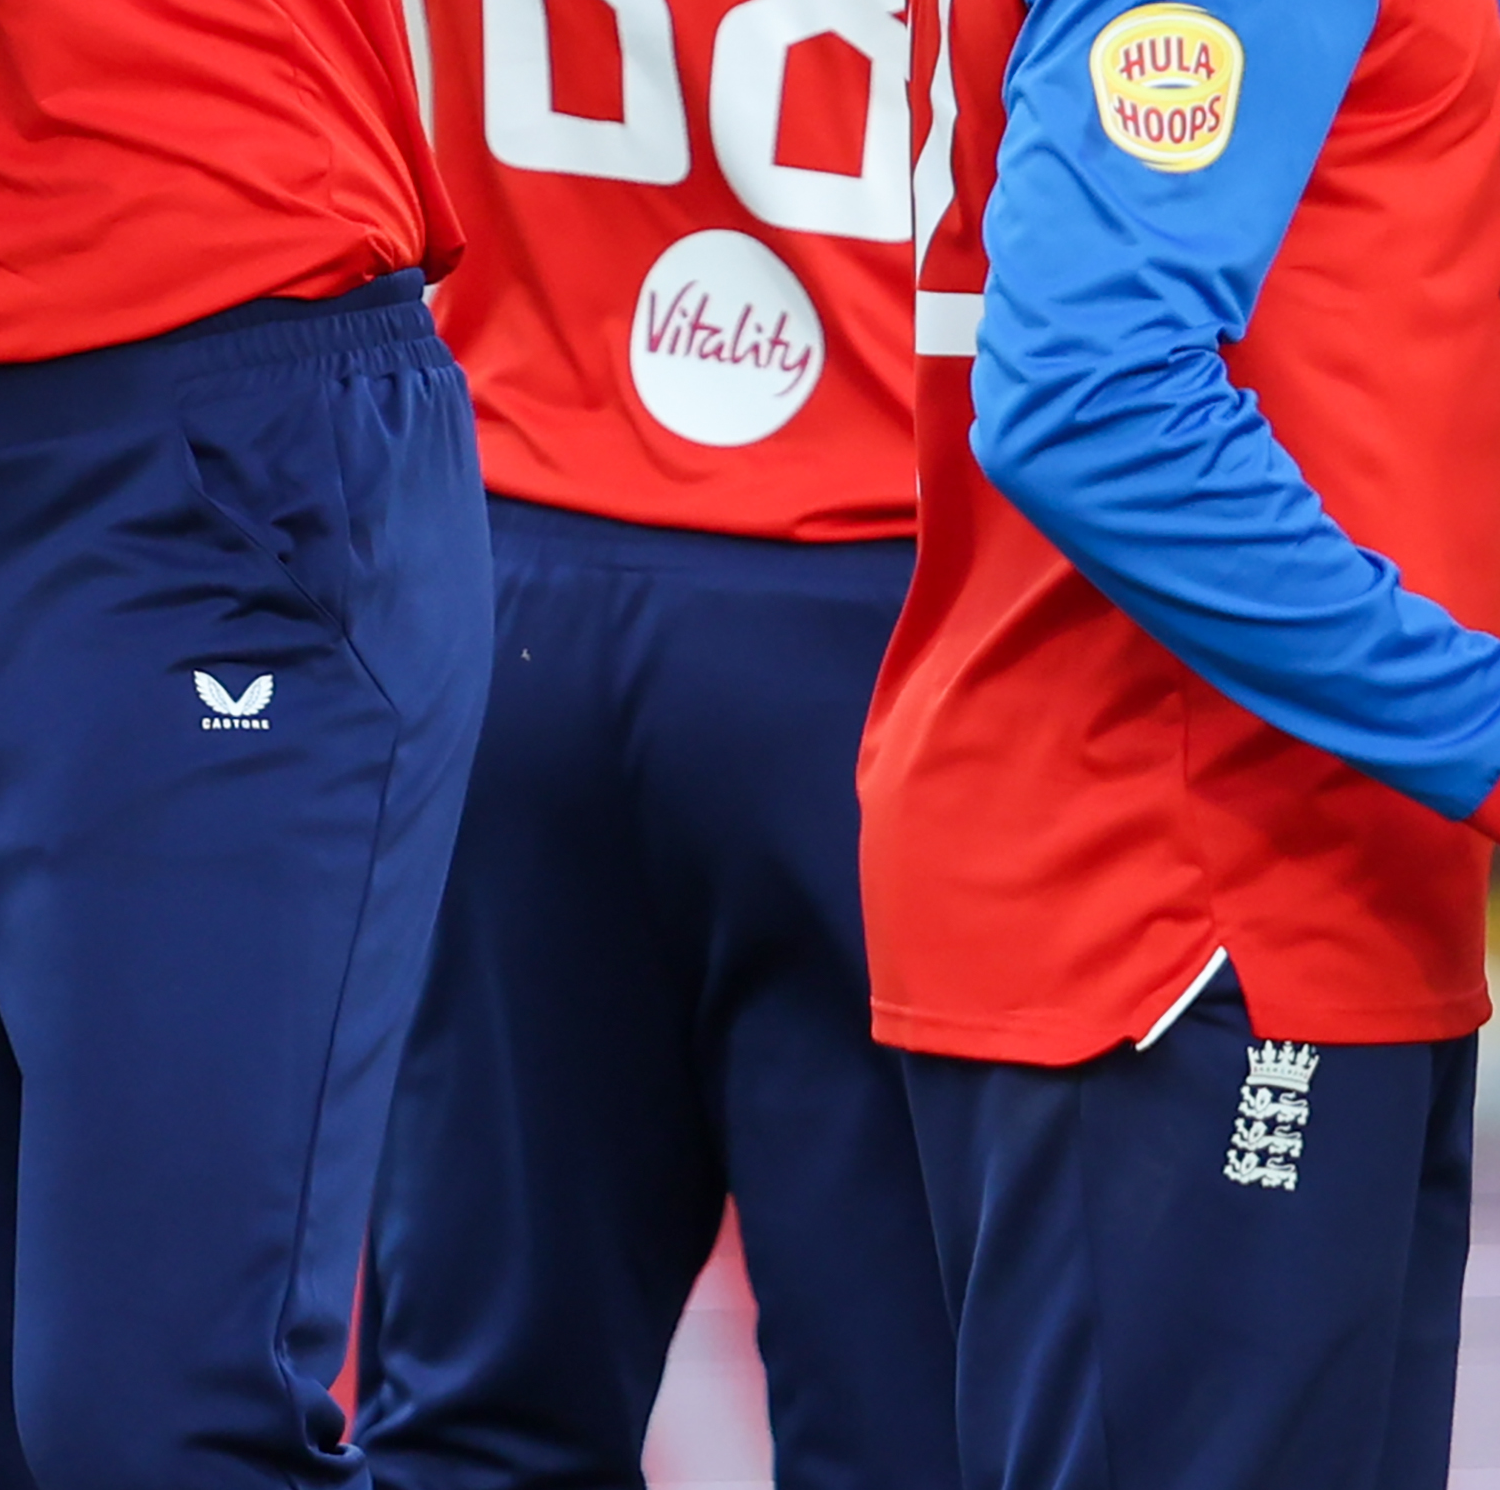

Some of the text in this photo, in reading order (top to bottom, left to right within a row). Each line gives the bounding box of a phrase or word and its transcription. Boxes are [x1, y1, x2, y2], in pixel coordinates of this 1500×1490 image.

[1119, 36, 1216, 82] HULA
[1113, 95, 1222, 144] HOOPS
[646, 280, 812, 397] Vitality
